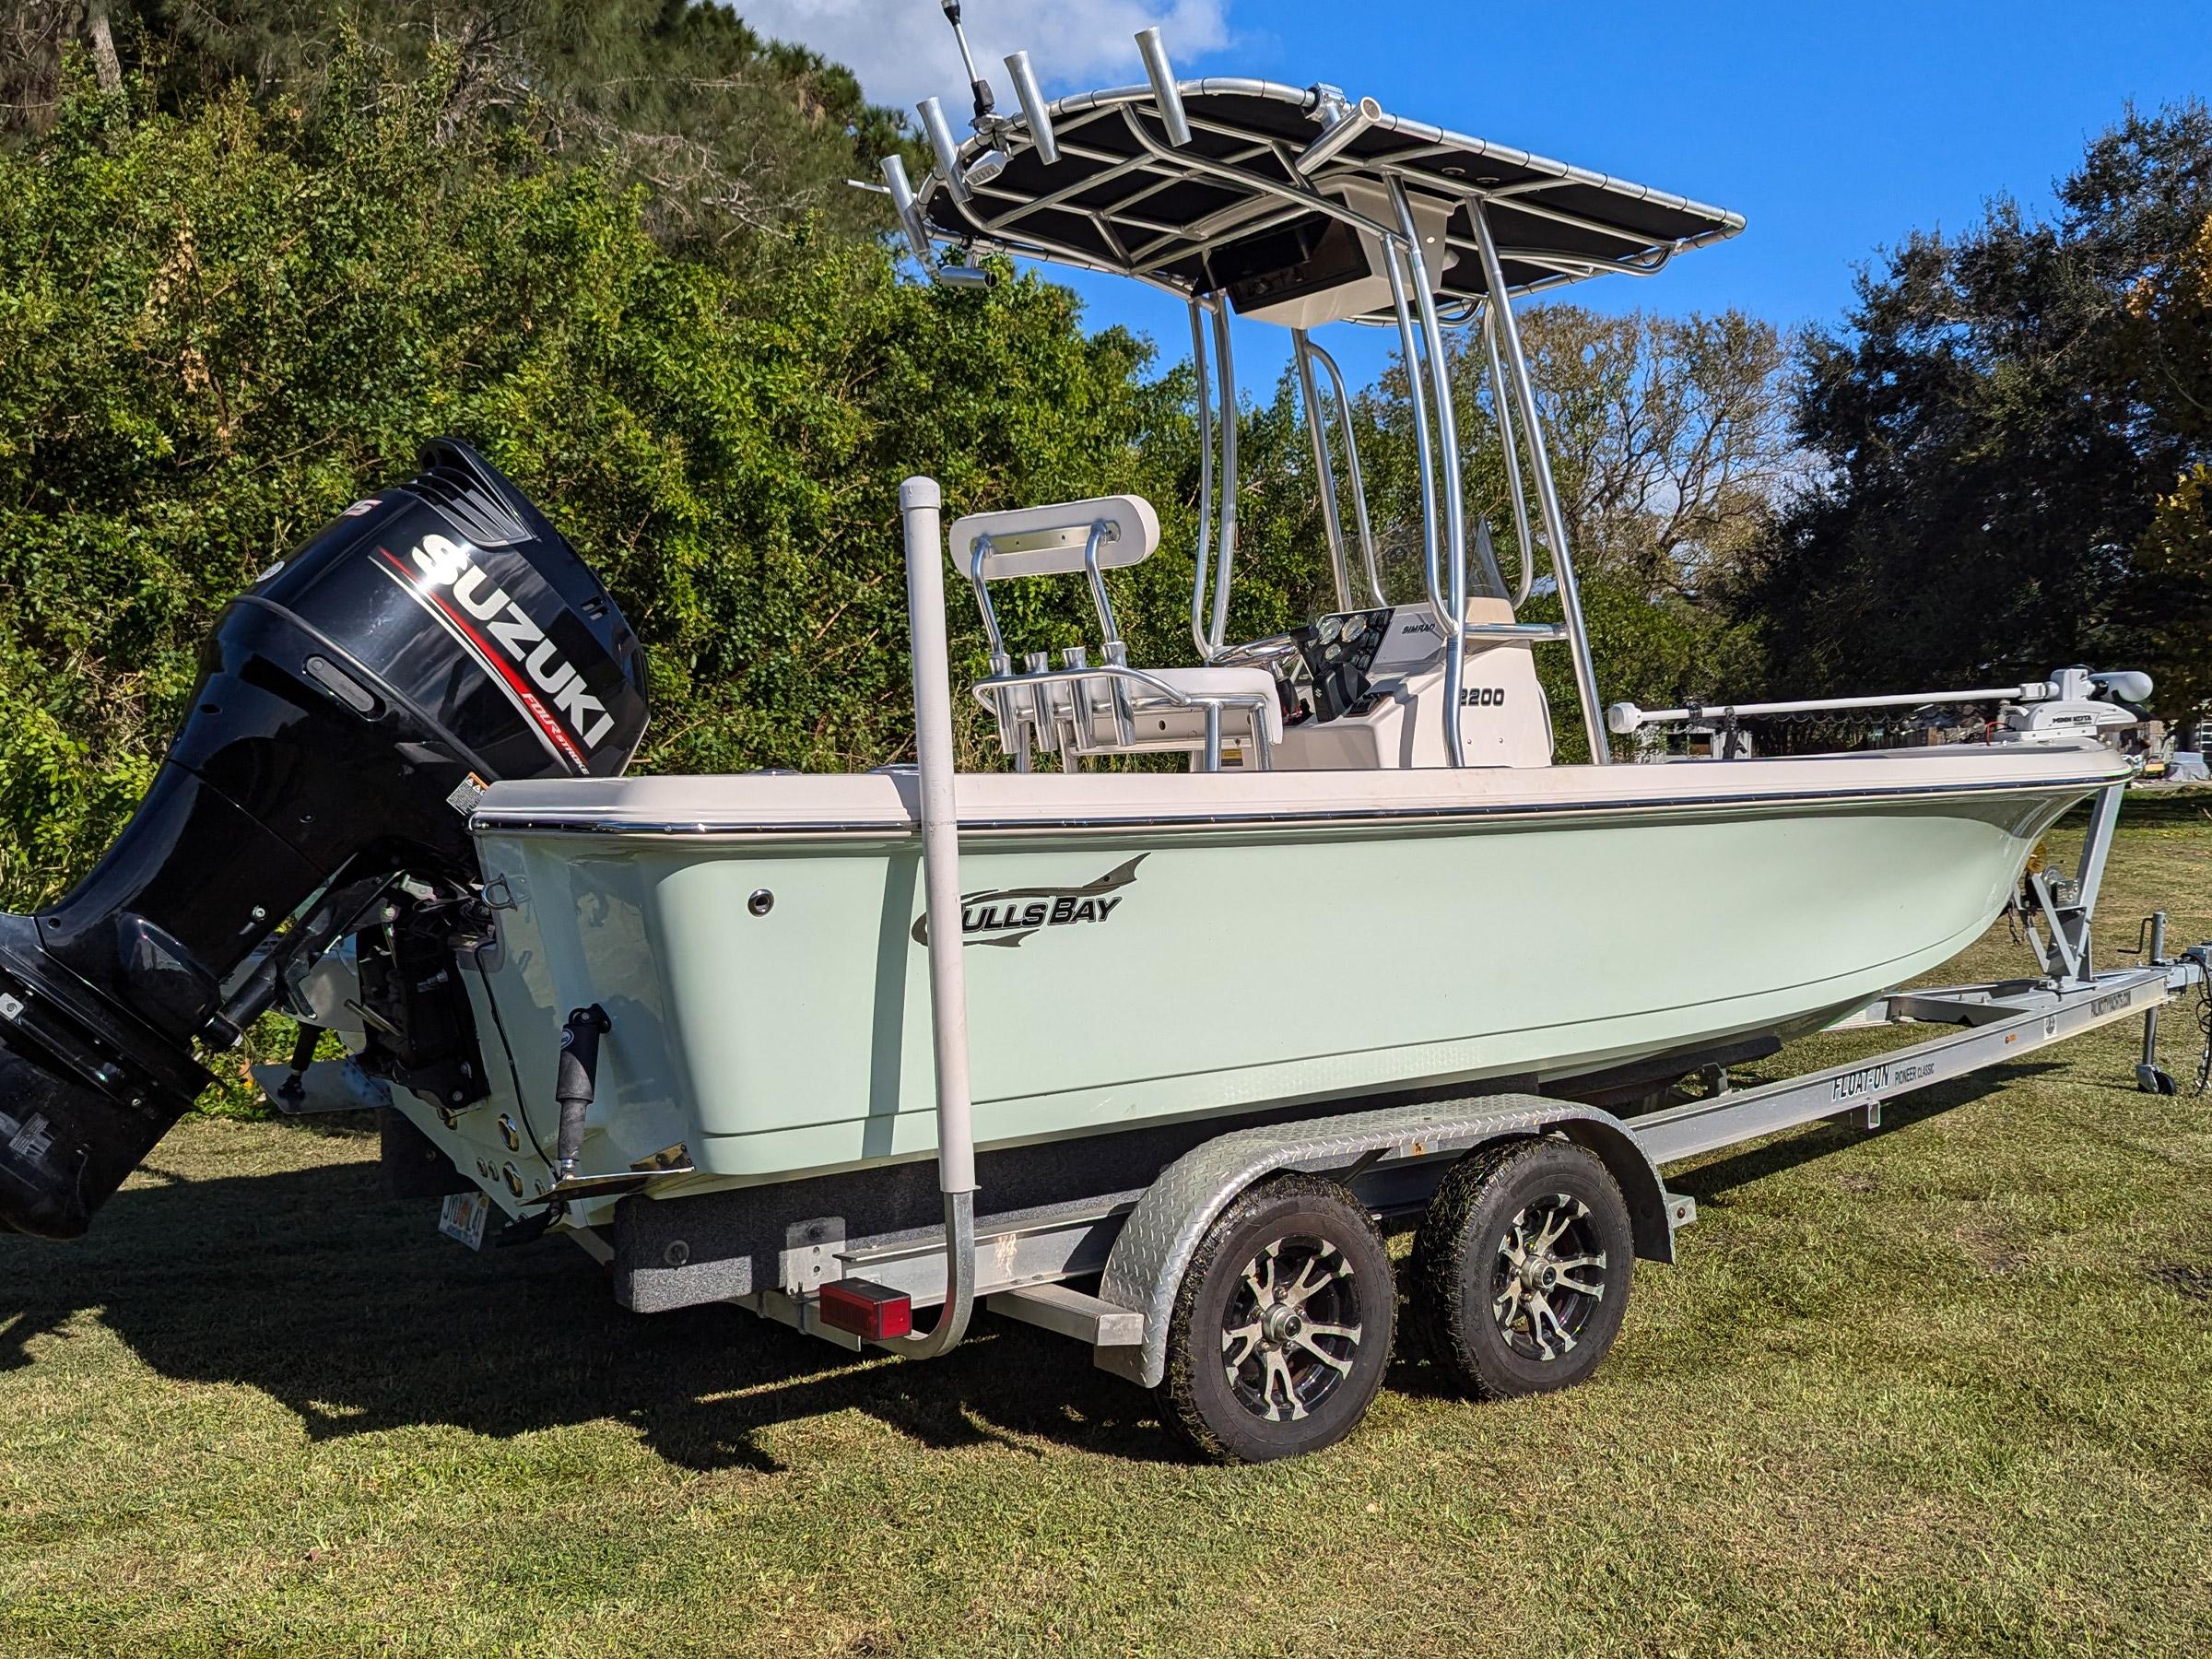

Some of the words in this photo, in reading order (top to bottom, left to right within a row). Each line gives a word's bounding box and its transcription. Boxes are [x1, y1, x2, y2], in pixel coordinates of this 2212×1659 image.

[412, 535, 615, 749] SUZUKI
[1401, 623, 1436, 635] SIMRAD
[1460, 688, 1505, 707] 2200
[521, 693, 562, 734] FOUR
[555, 734, 590, 775] STROKE
[961, 901, 1049, 934] ULLS
[1831, 1065, 1889, 1100] FLOAT-ON
[1895, 1066, 1916, 1086] PIONEER
[1917, 1063, 1935, 1078] CLASSIC
